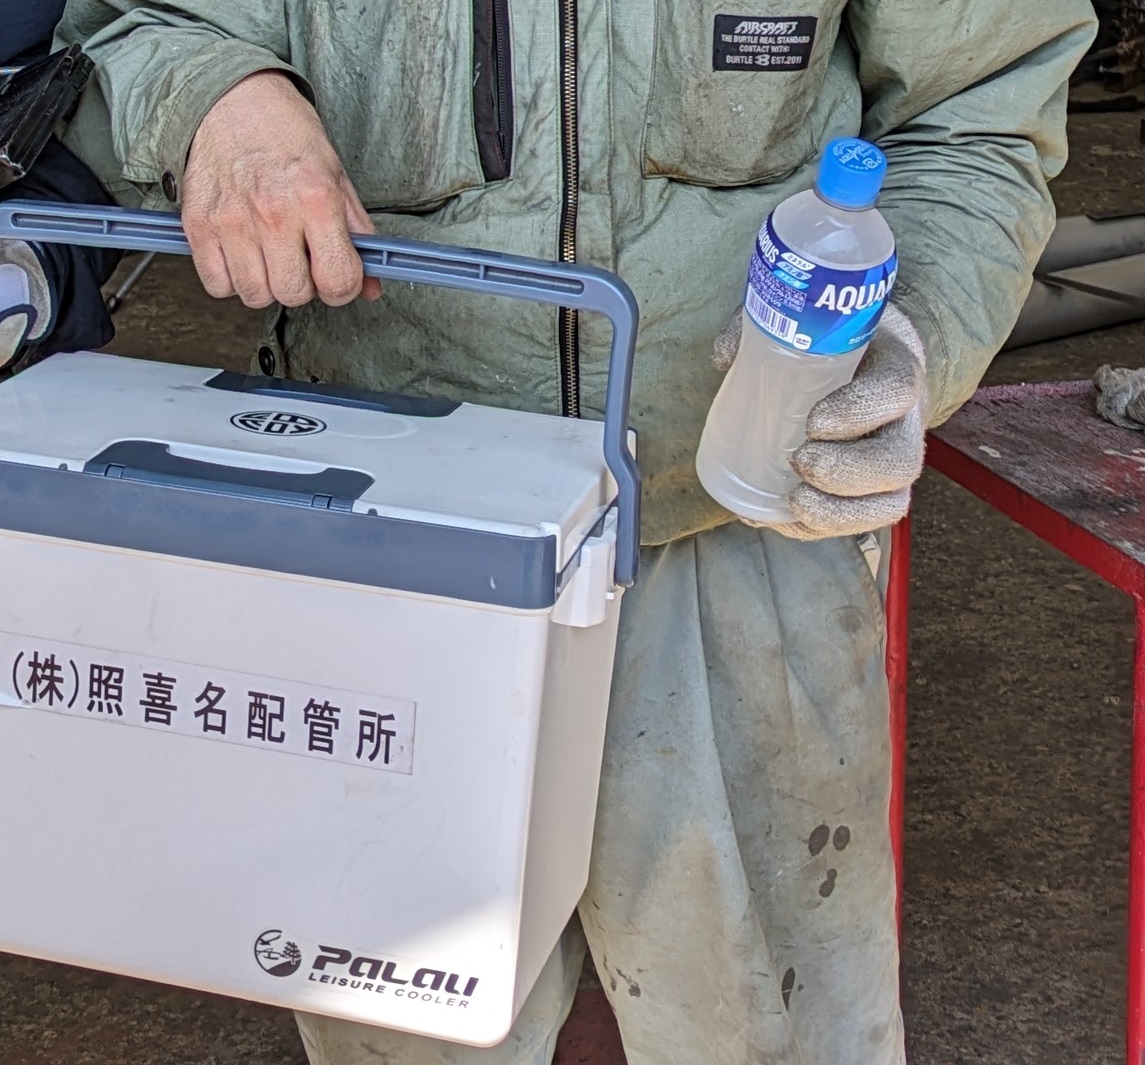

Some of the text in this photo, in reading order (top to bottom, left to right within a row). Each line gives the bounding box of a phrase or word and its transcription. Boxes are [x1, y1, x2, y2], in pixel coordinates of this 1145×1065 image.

[734, 21, 798, 35] AIRCRAFT
[721, 34, 810, 44] THE BURTLE REAL STANDARD
[739, 45, 770, 53] CONTACT
[726, 55, 802, 65] BURTLE EST.2011
[308, 972, 471, 1009] LEISURE COOLER
